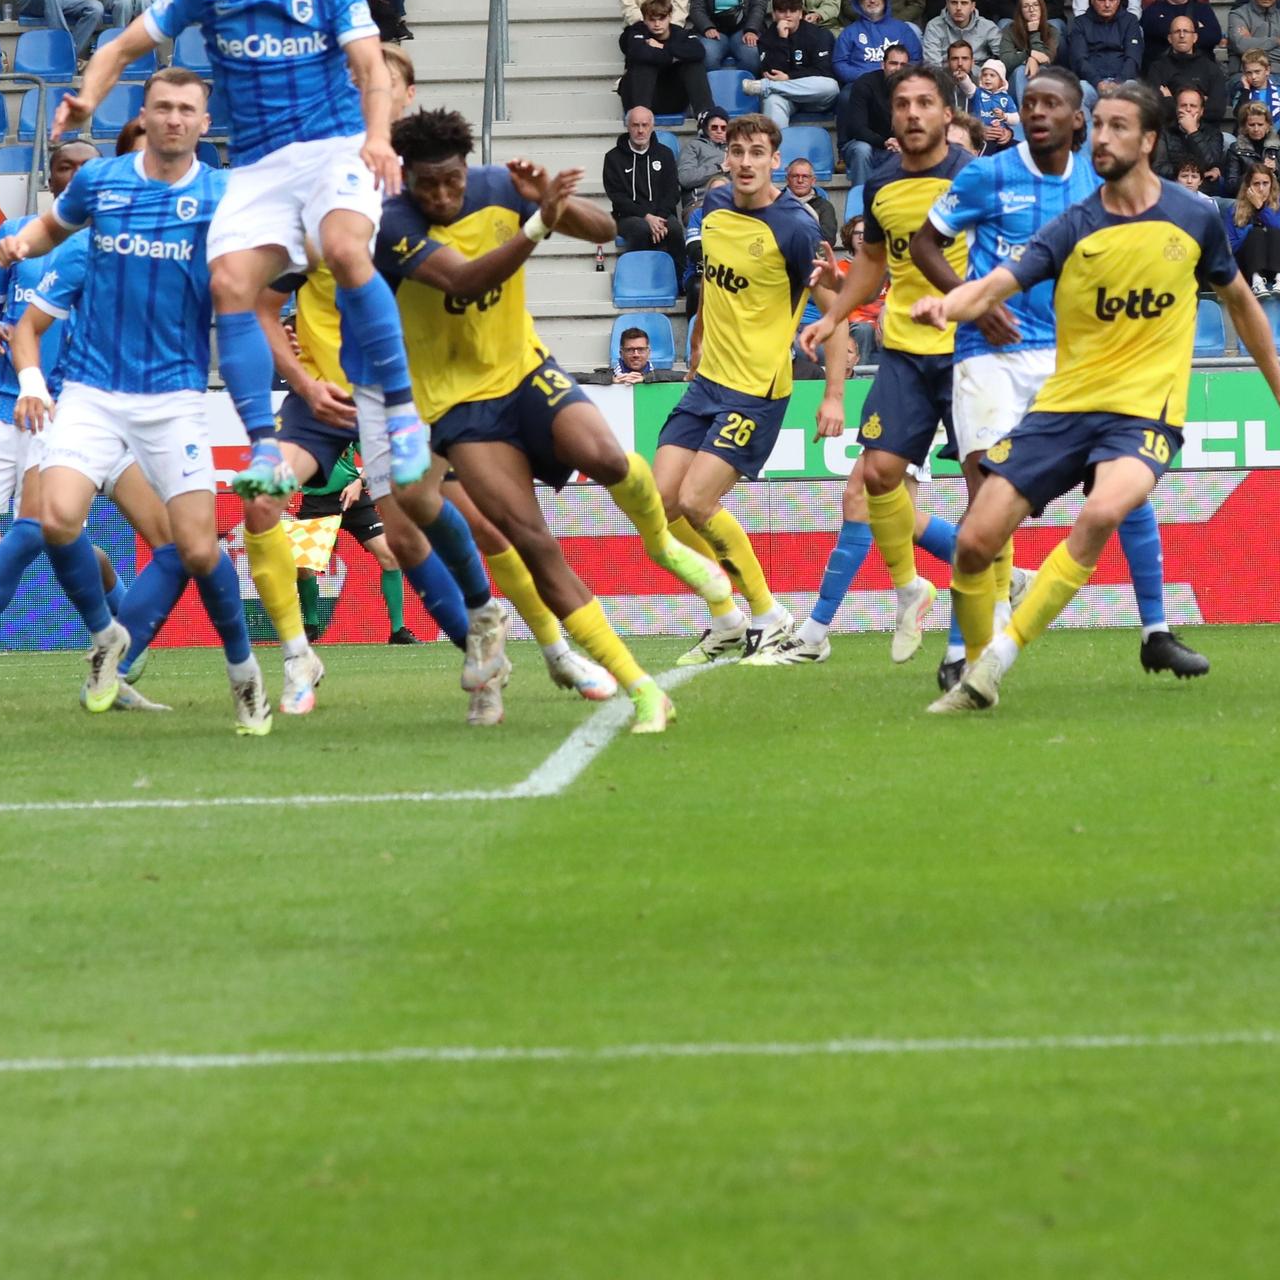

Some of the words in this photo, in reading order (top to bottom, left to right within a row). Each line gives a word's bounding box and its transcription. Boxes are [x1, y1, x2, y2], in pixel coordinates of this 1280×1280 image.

[531, 368, 572, 396] 13
[720, 412, 757, 447] 26
[1143, 429, 1170, 464] 16
